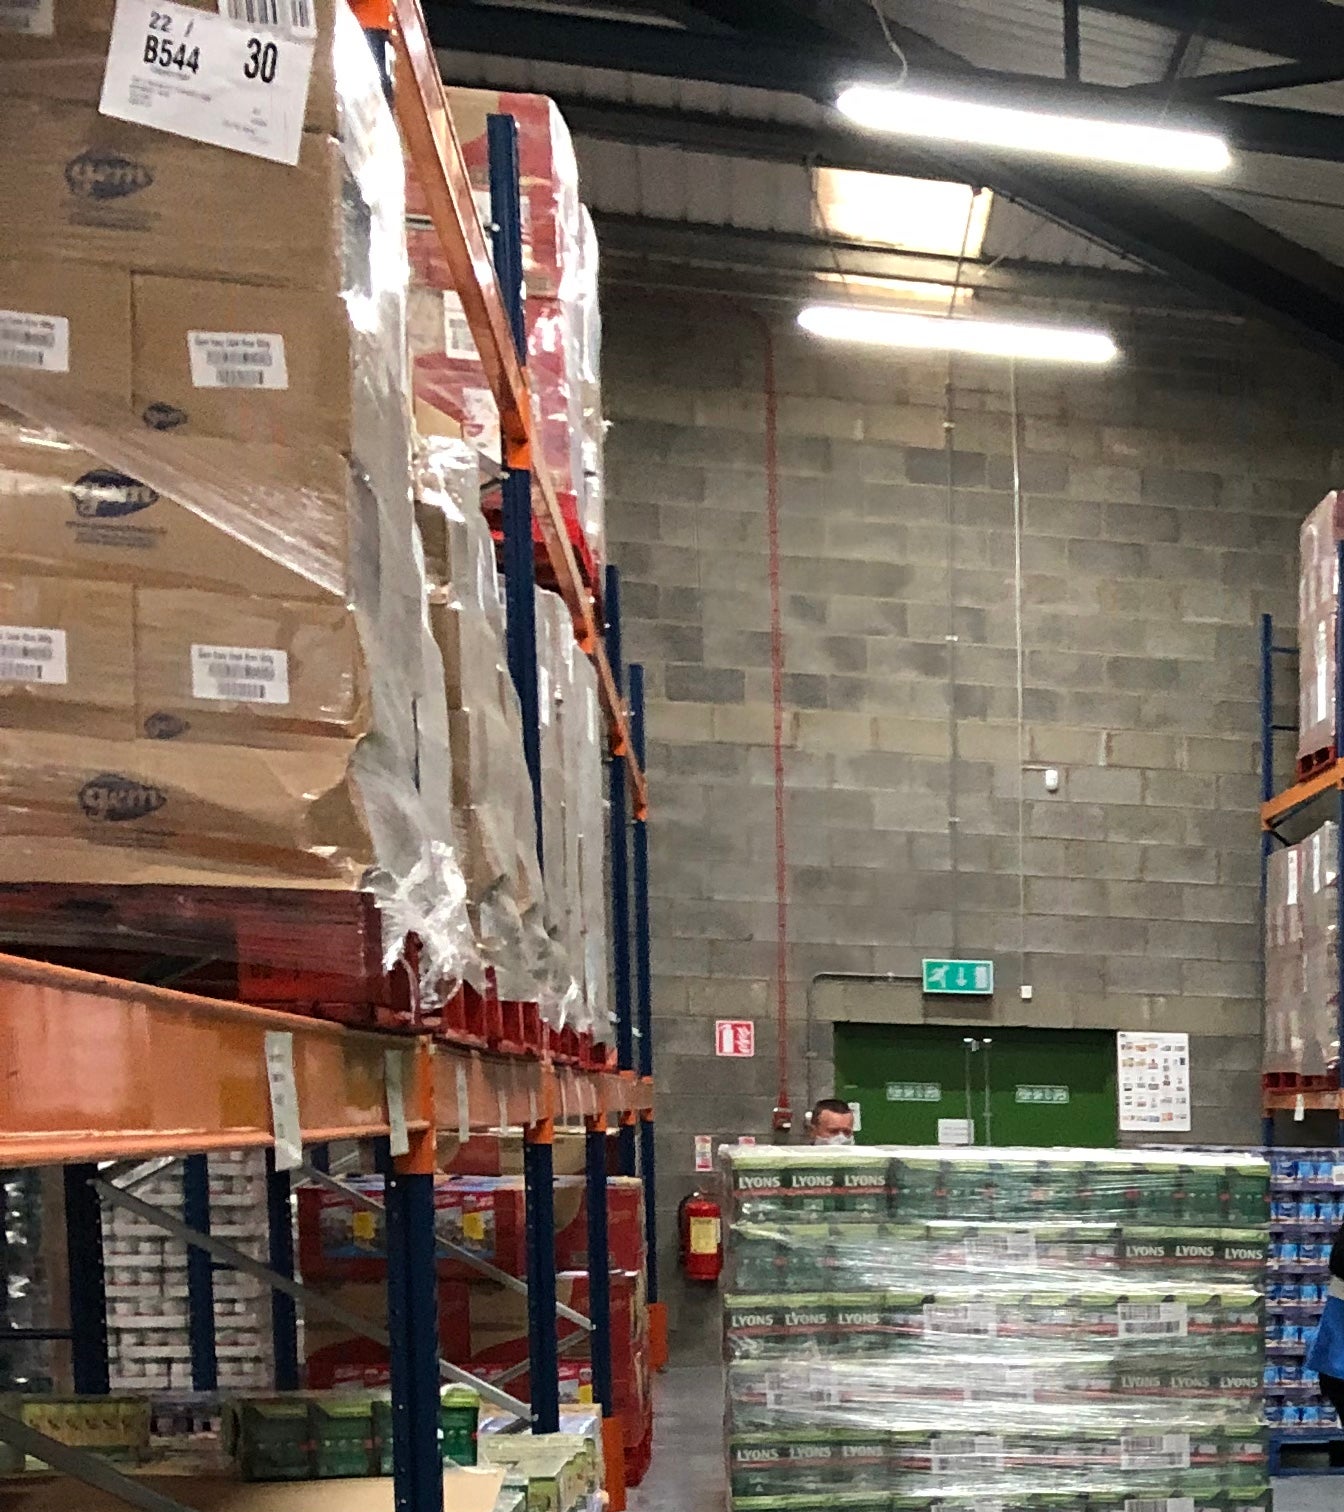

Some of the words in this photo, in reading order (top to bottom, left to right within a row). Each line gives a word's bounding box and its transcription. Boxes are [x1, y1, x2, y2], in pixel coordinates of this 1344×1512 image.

[144, 35, 200, 74] B544
[244, 38, 278, 84] 30
[739, 1176, 781, 1189] LYONS
[792, 1175, 834, 1187] LYONS
[844, 1174, 886, 1186] LYONS
[1126, 1245, 1165, 1257] LYONS
[1175, 1244, 1215, 1257] LYONS
[1225, 1247, 1264, 1260] LYONS
[732, 1314, 774, 1328] LYONS
[785, 1312, 827, 1326] LYONS
[837, 1311, 880, 1325] LYONS
[737, 1448, 779, 1462] LYONS
[789, 1445, 832, 1459] LYONS
